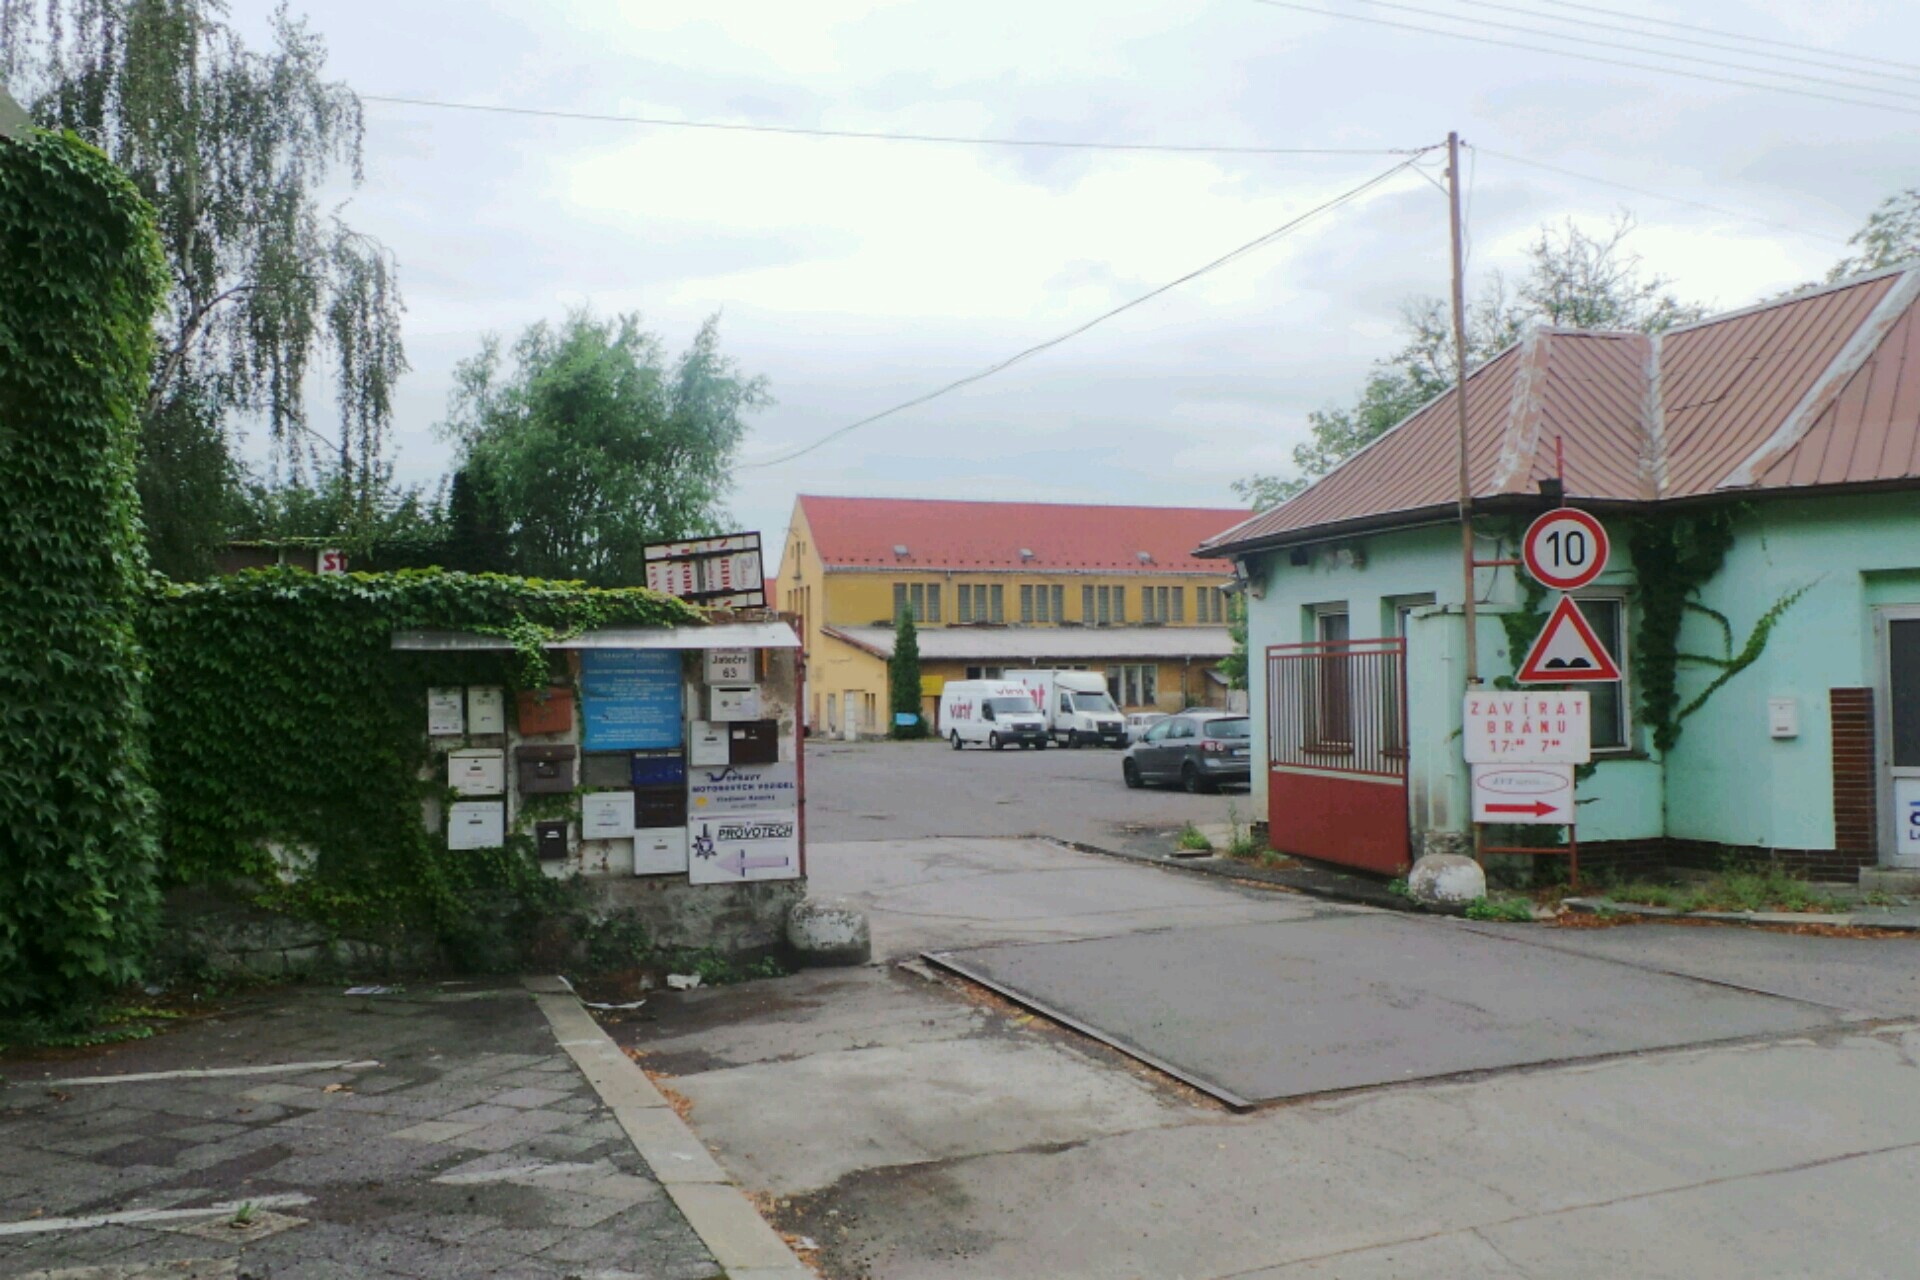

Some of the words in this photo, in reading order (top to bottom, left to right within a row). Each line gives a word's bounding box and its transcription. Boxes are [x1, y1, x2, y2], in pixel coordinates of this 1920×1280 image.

[1546, 531, 1585, 567] 10
[722, 668, 738, 679] 63
[1471, 696, 1582, 715] ZAVÍRAT
[1487, 716, 1565, 734] BRÁNU
[718, 826, 793, 841] PROVOTECH
